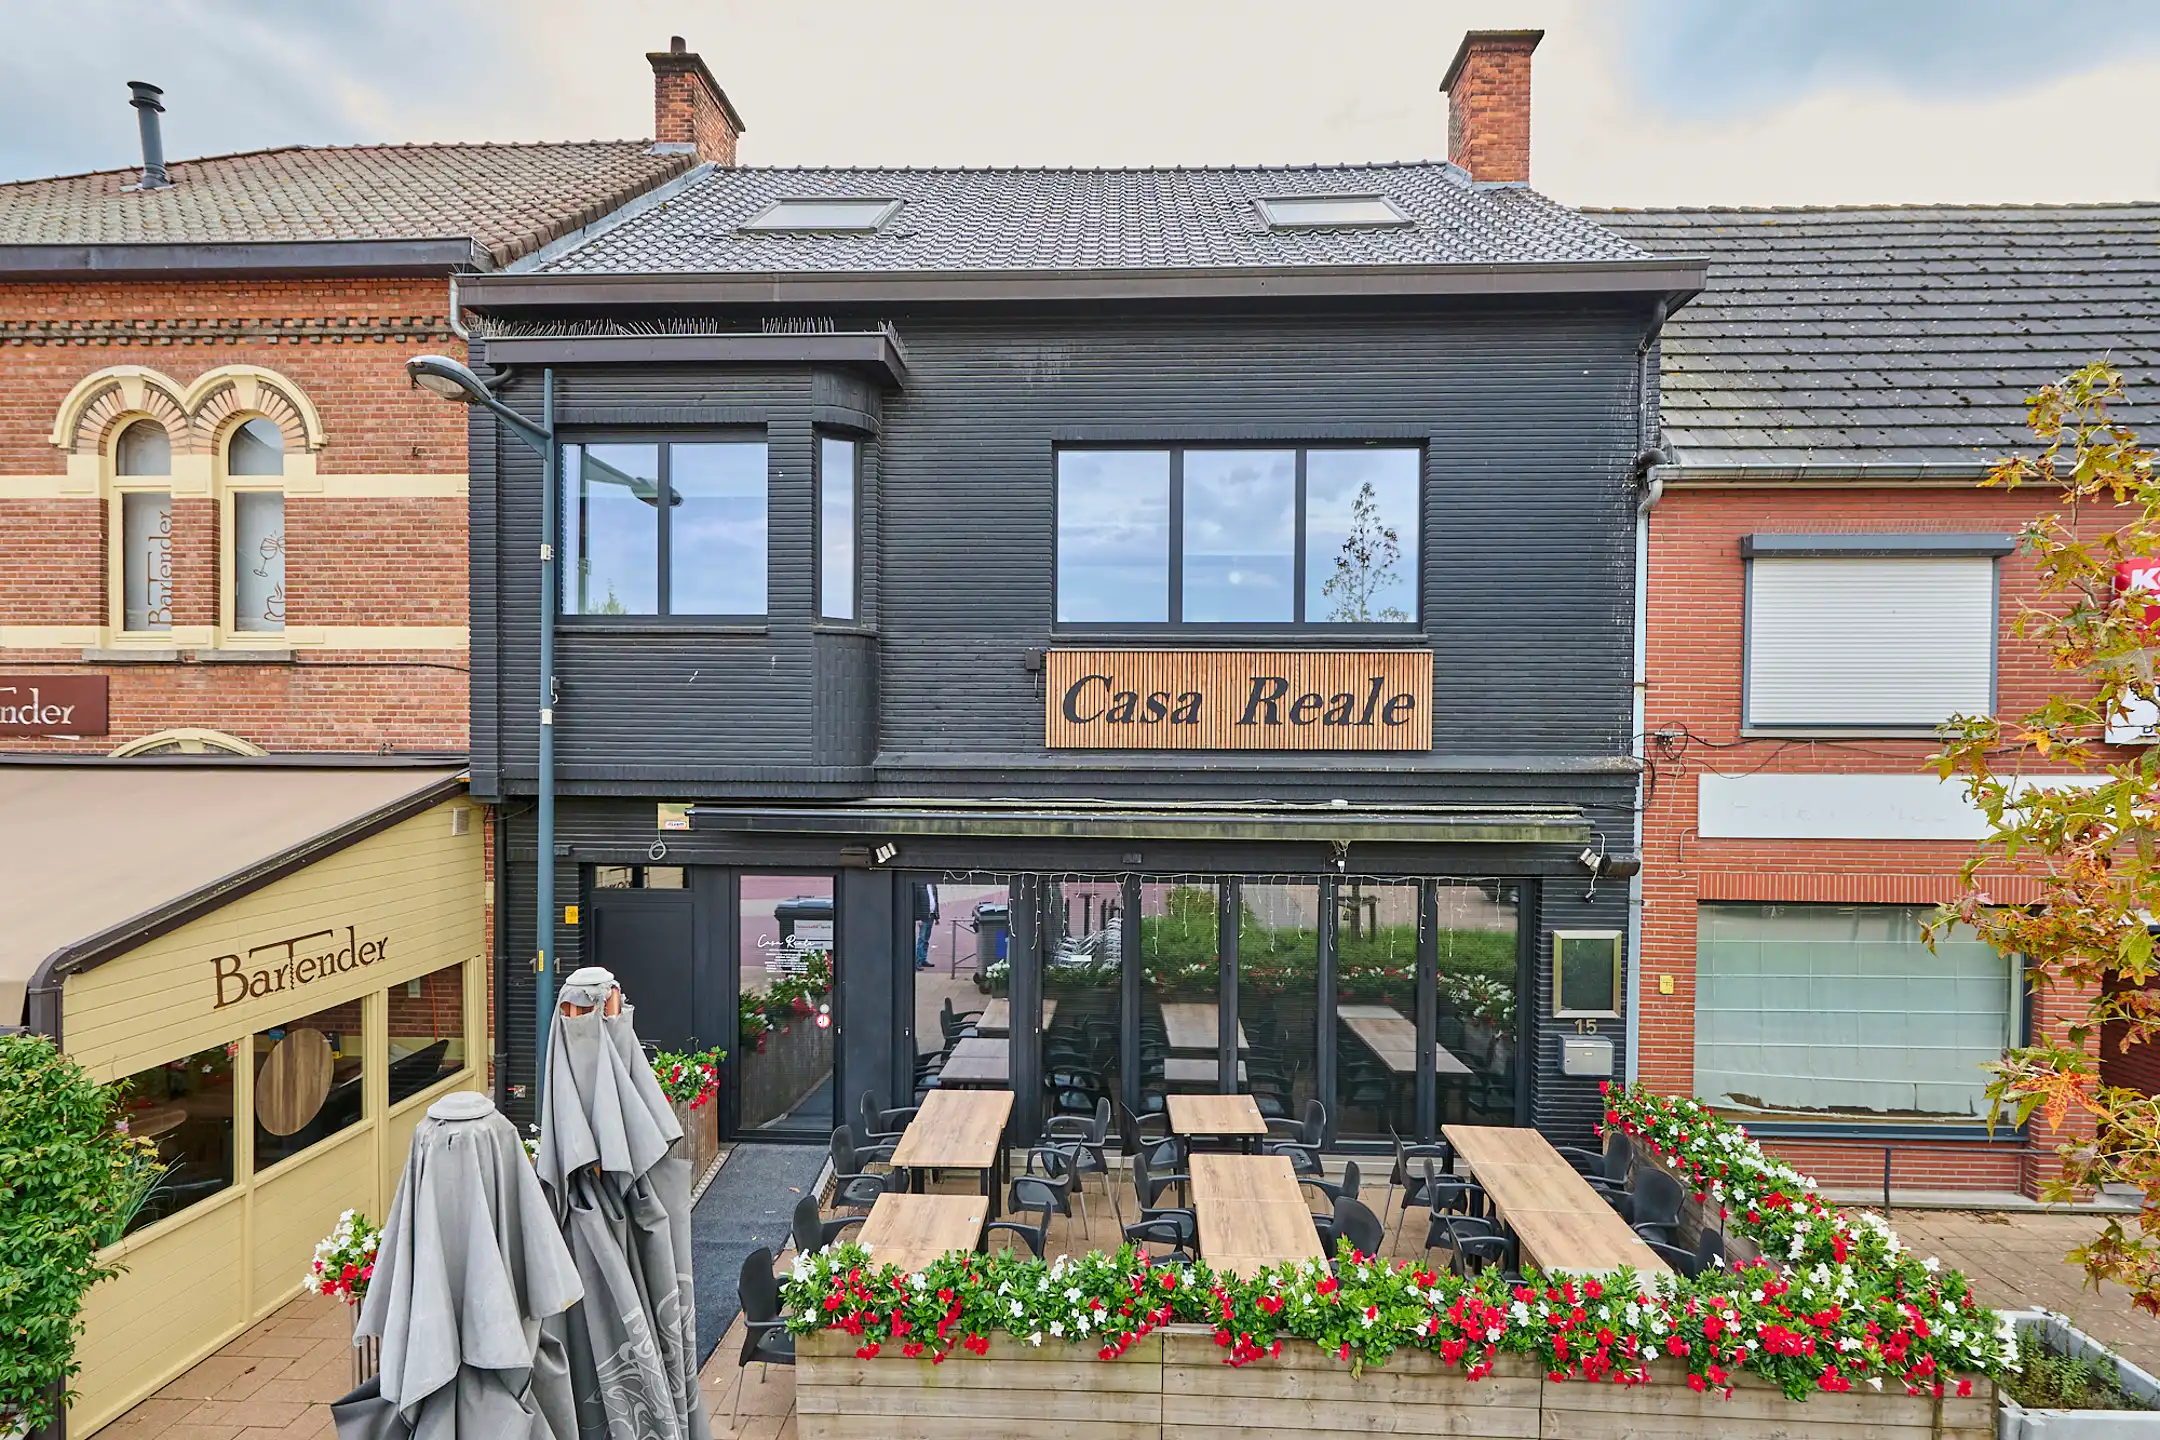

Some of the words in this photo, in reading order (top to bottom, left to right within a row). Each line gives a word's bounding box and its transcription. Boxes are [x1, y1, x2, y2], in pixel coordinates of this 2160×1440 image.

[0, 687, 75, 725] nder
[1062, 674, 1202, 725] Casa
[1235, 676, 1416, 727] Reale
[1574, 1018, 1598, 1035] 15
